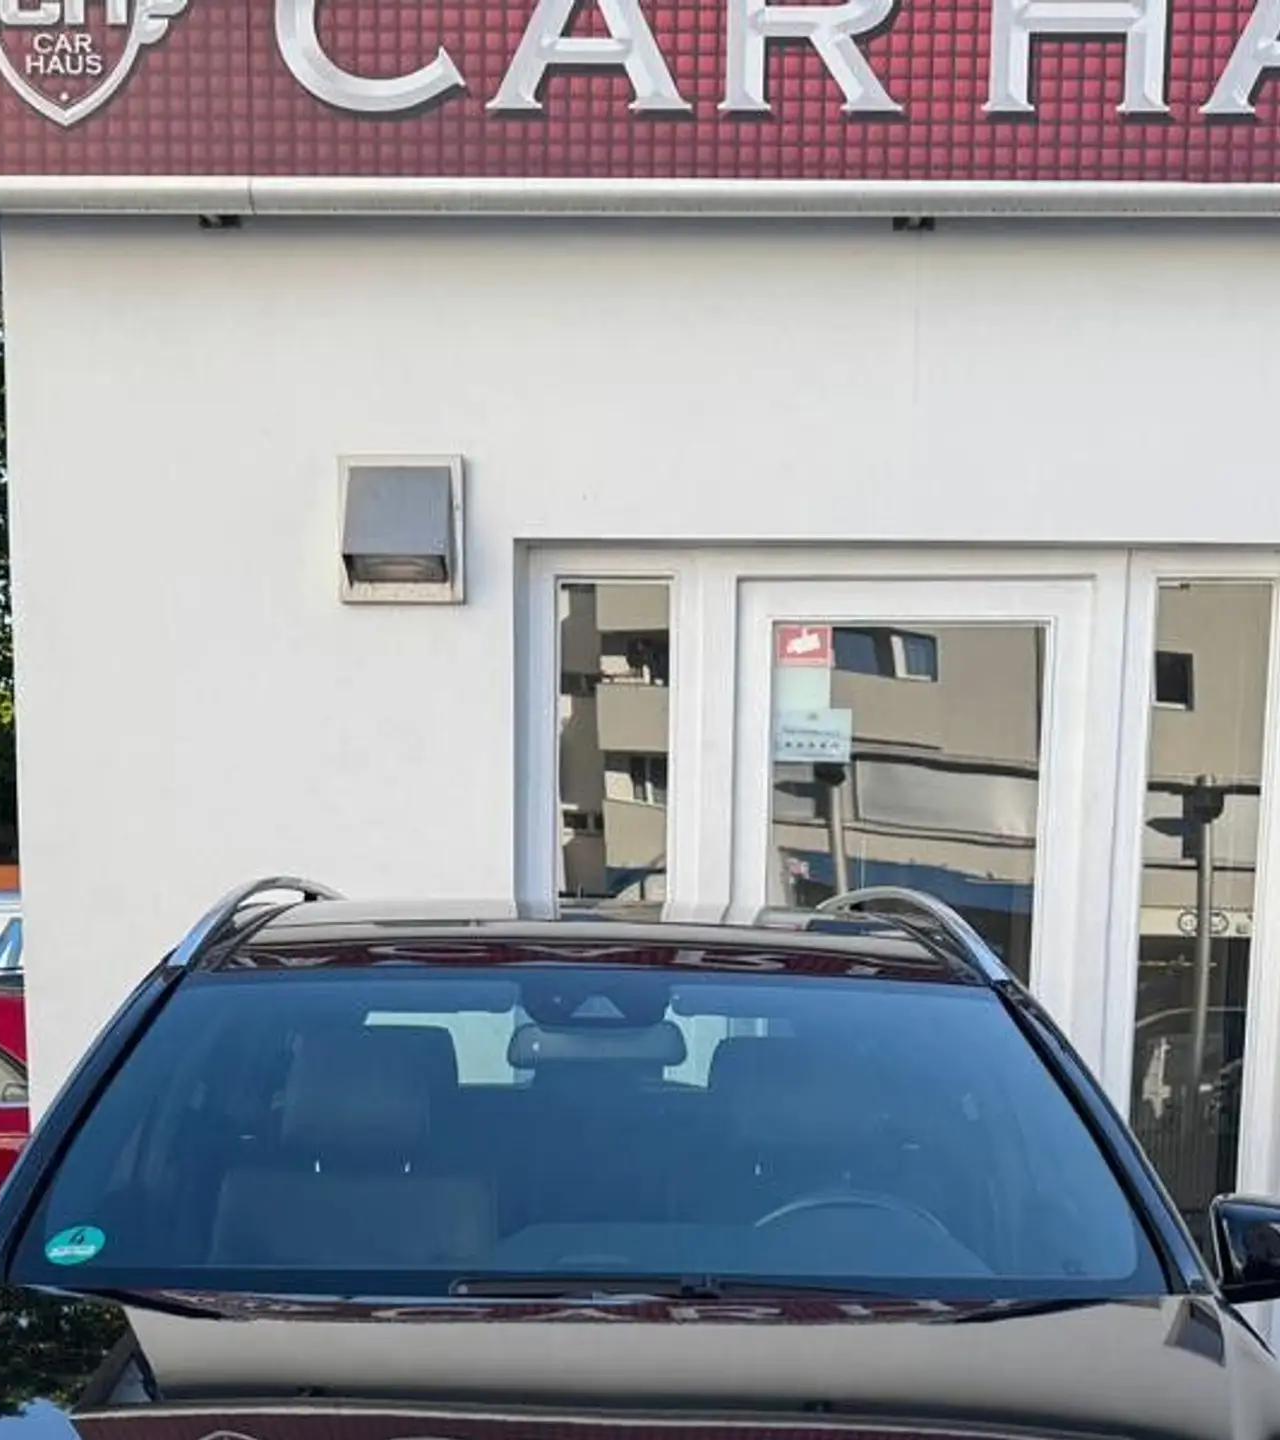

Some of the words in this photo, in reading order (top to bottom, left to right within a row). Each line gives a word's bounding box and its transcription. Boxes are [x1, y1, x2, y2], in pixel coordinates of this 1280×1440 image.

[32, 33, 93, 54] CAR
[24, 54, 103, 75] HAUS
[275, 0, 904, 112] CAR
